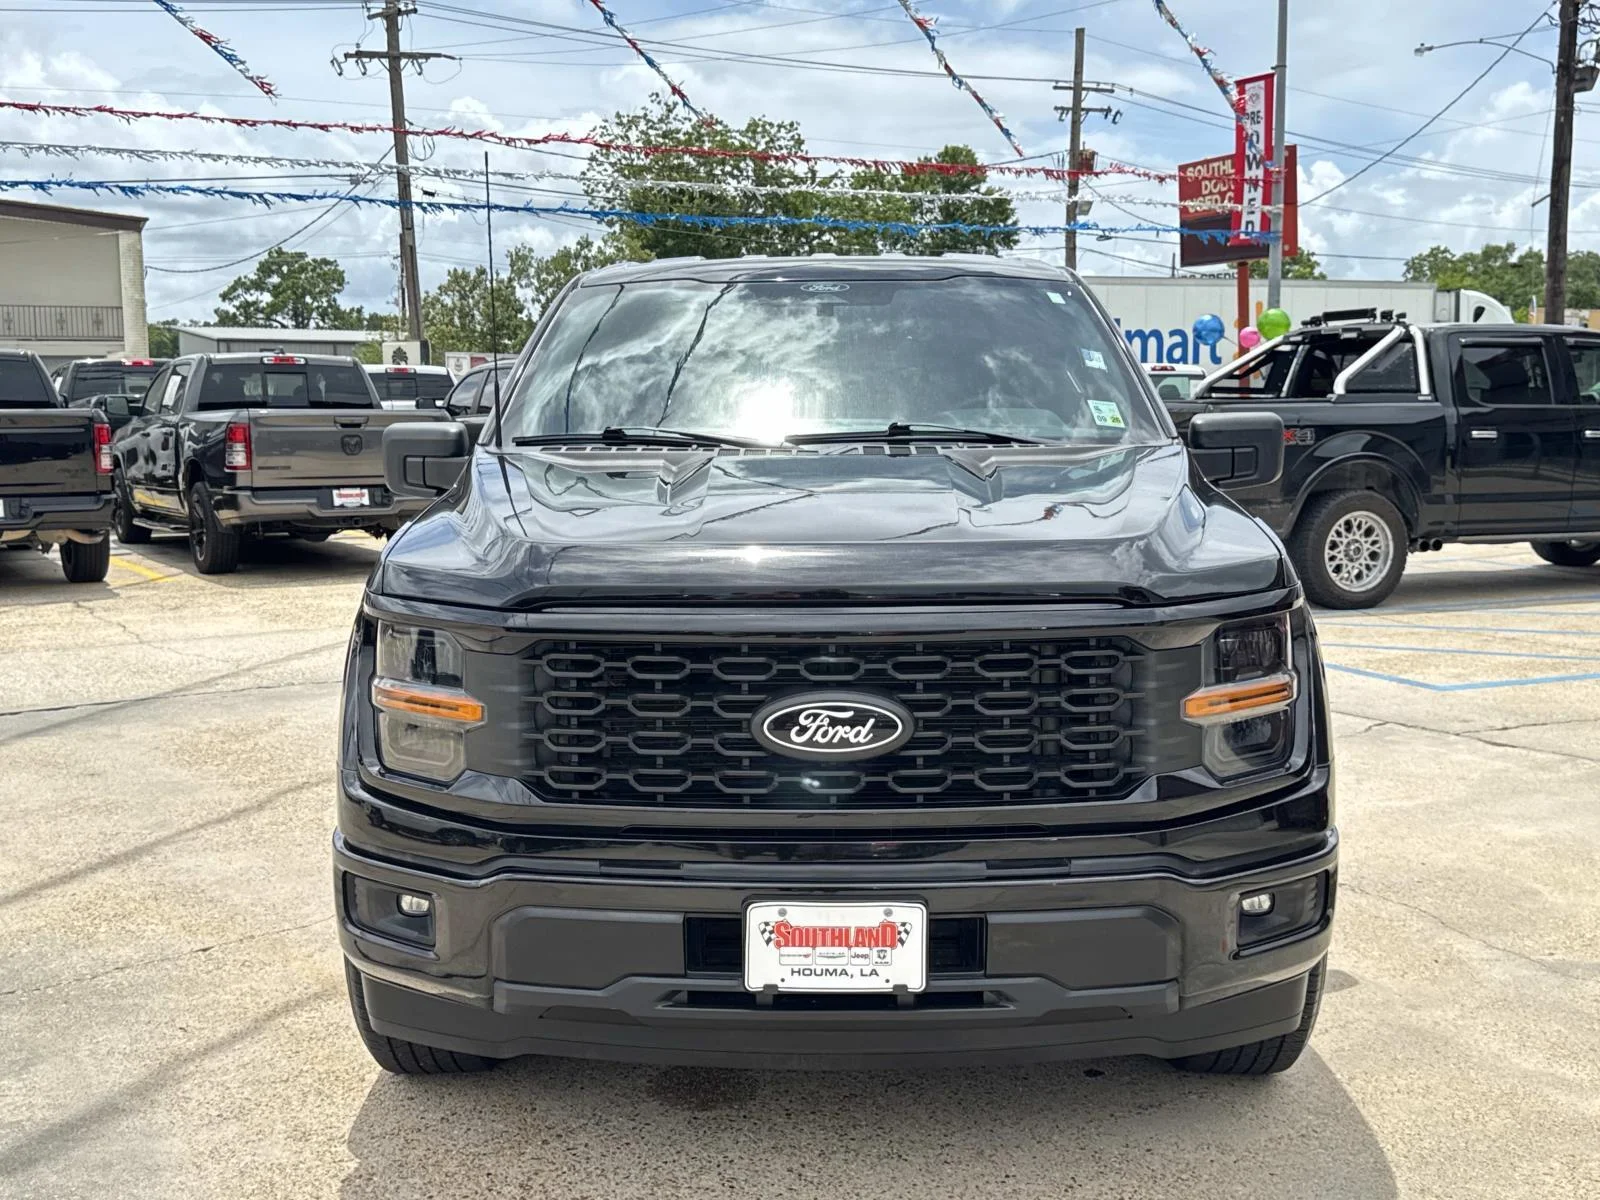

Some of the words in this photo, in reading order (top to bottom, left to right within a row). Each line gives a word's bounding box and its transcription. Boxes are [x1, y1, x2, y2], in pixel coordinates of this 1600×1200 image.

[1186, 159, 1236, 182] SOUTHL
[808, 284, 841, 292] Ford
[790, 709, 876, 744] Ford
[774, 921, 898, 950] SOUTHLAND
[850, 952, 870, 960] Jeep
[791, 967, 854, 979] HOUMA,
[860, 967, 880, 977] LA
